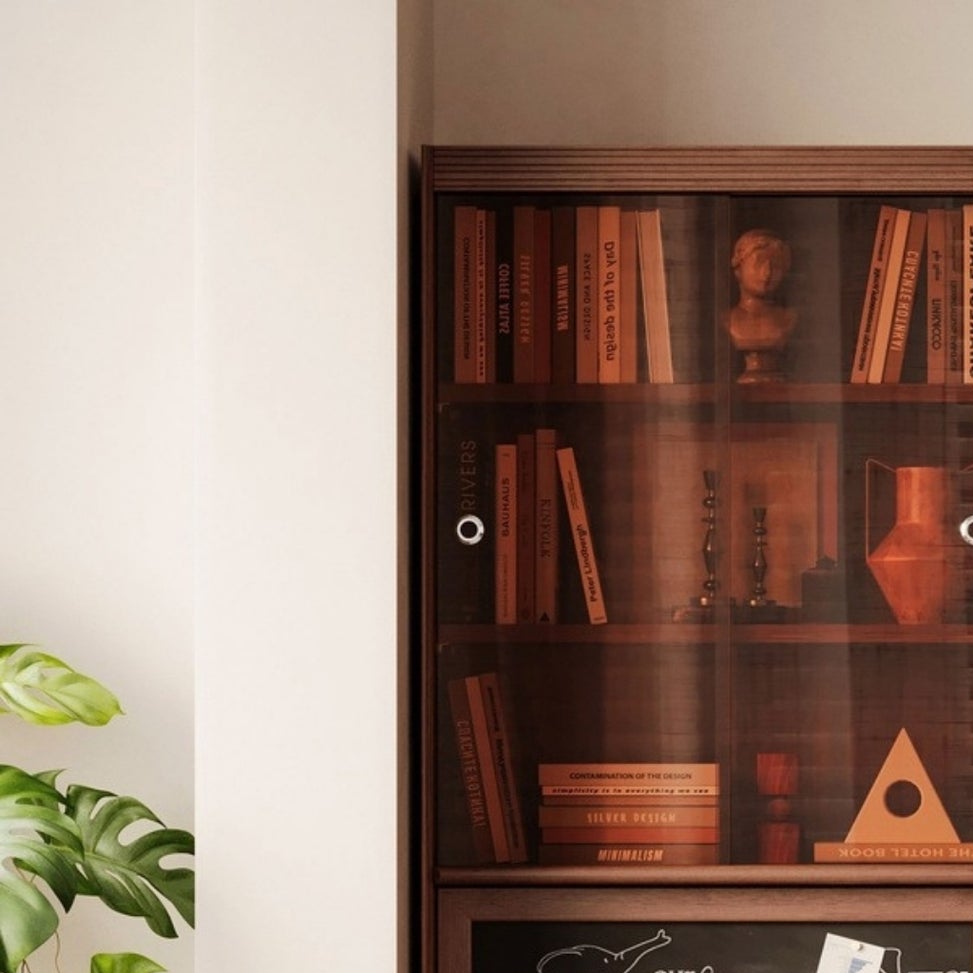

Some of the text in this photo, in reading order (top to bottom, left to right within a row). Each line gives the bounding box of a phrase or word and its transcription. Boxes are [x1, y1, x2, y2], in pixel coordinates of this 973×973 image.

[461, 440, 476, 512] RIVERS
[501, 478, 510, 537] BAUHAUS
[576, 524, 598, 602] Peter Lindbergh
[587, 813, 676, 823] SILVER DESIGN
[597, 849, 664, 861] MINIMALISM
[840, 849, 885, 857] BOOK
[890, 849, 944, 857] HOTEL
